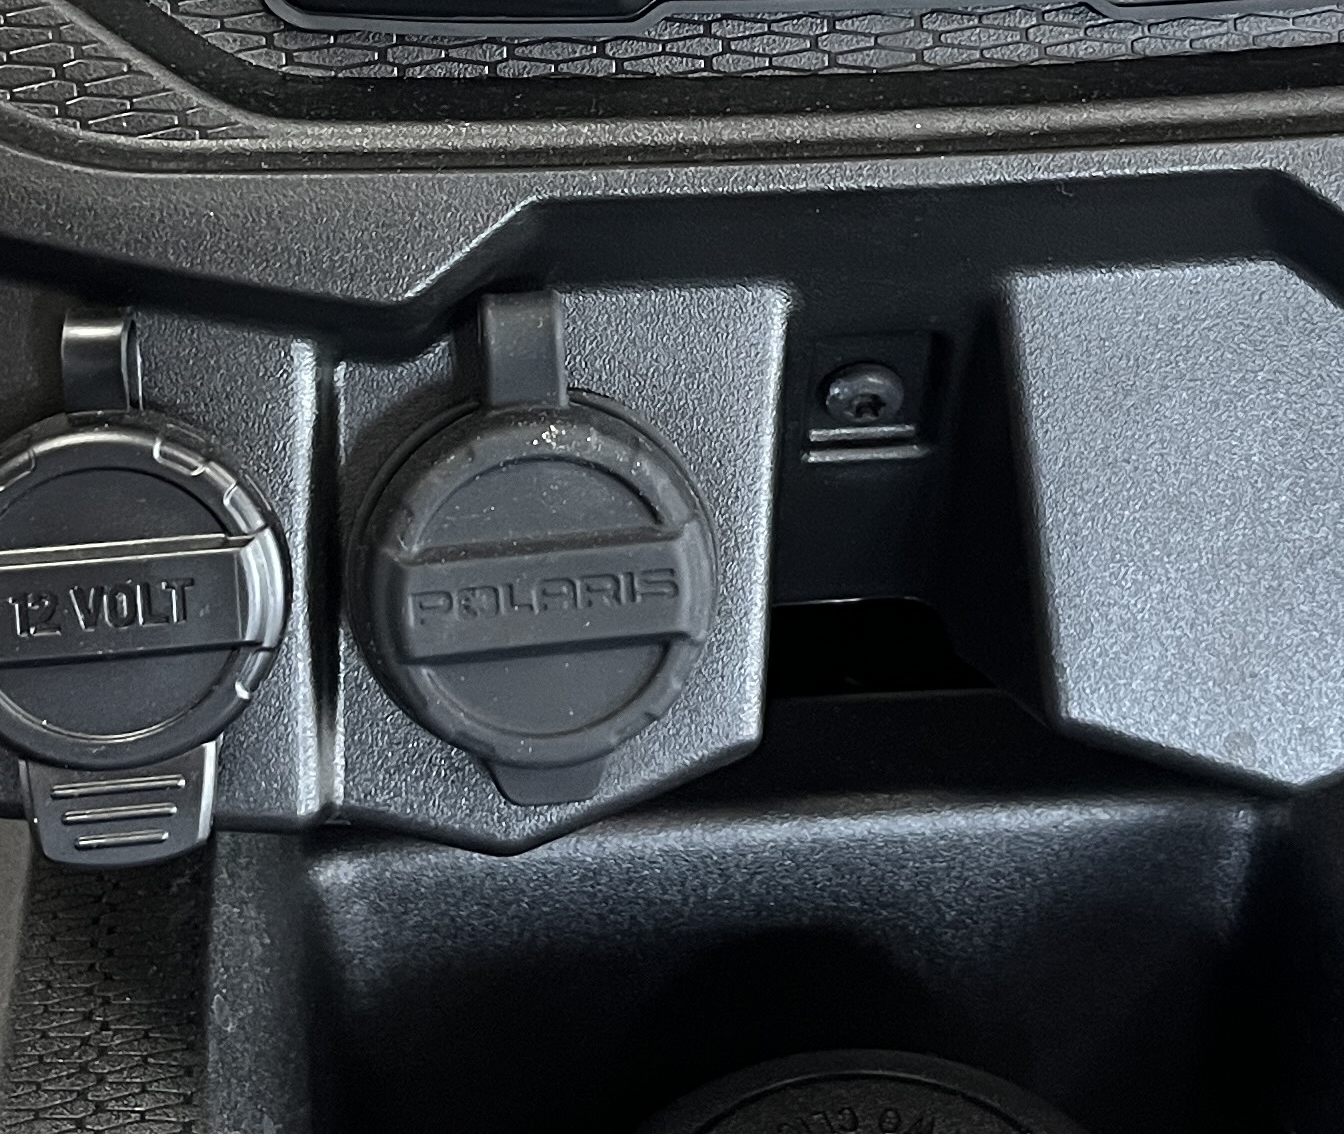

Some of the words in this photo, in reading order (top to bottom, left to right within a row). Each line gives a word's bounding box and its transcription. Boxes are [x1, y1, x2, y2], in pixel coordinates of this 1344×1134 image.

[7, 592, 61, 636] 12
[73, 577, 196, 630] VOLT
[407, 568, 680, 627] POLARIS
